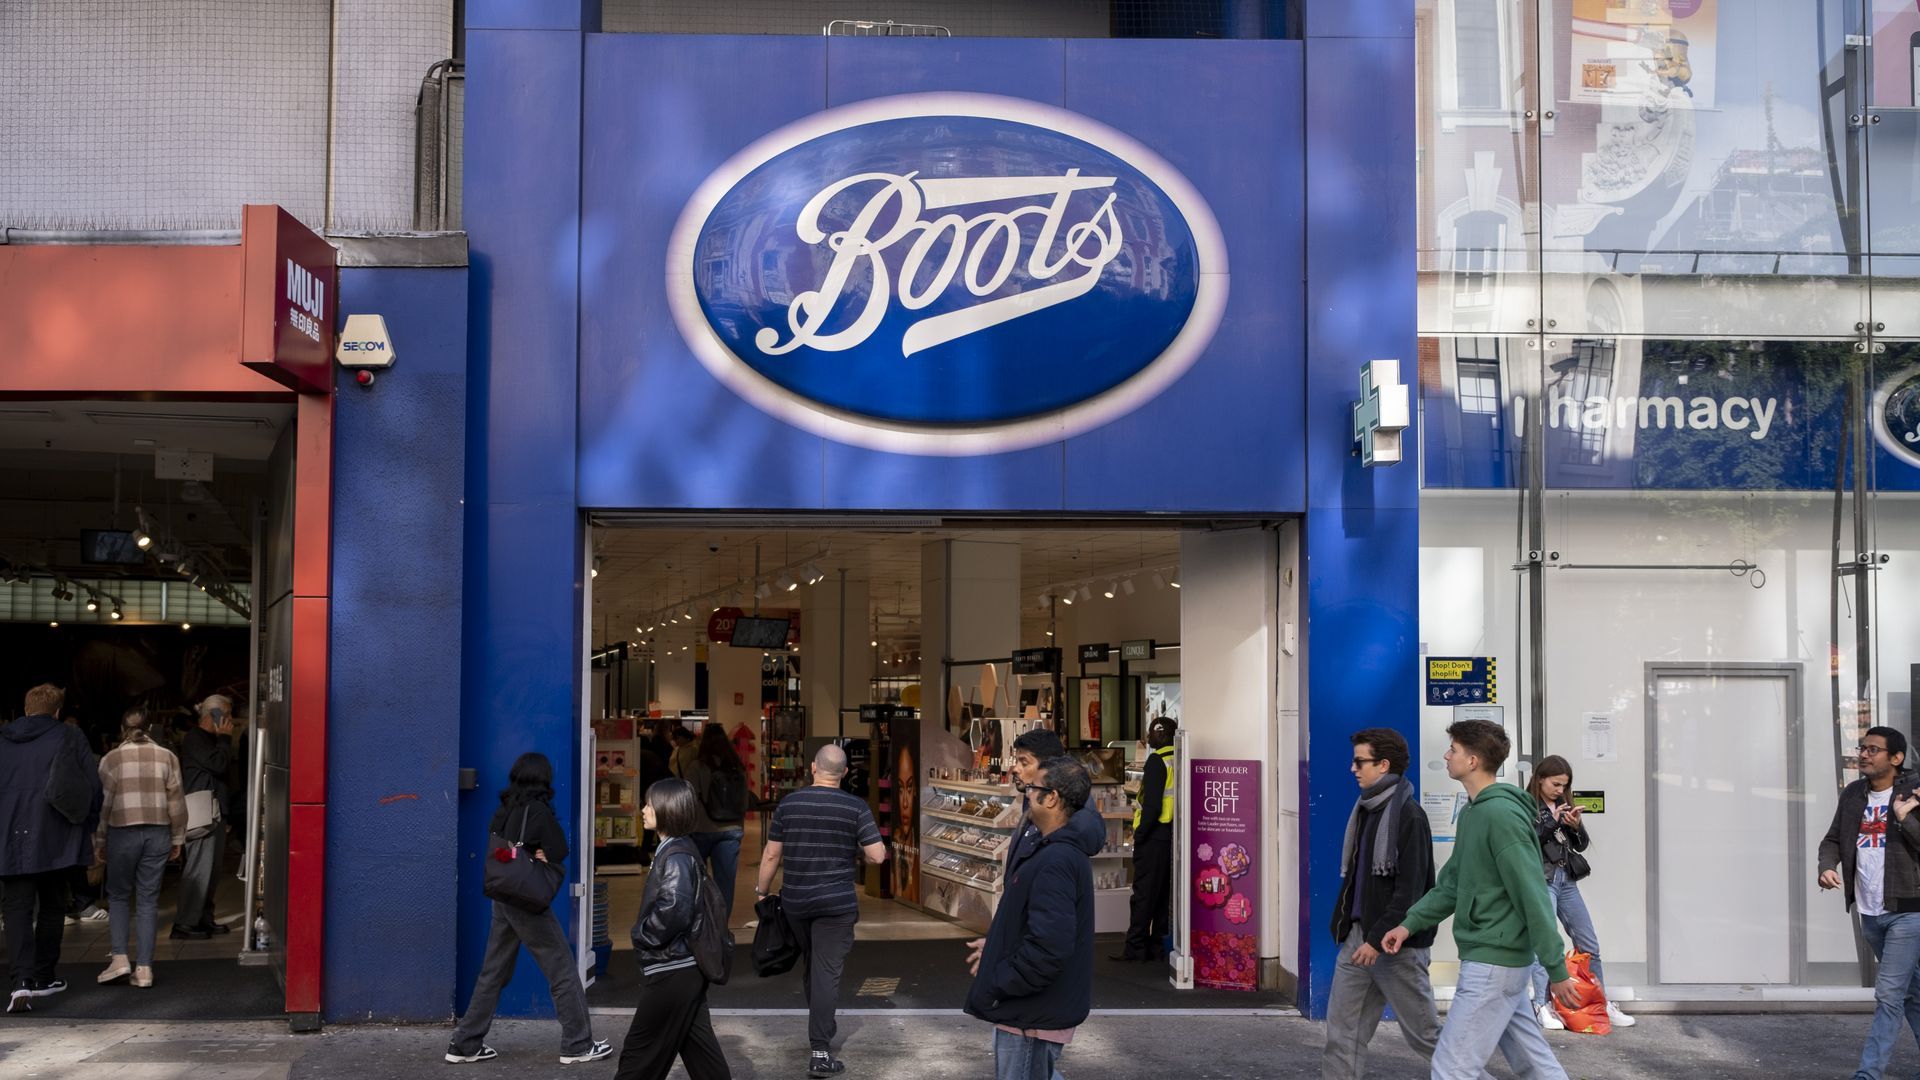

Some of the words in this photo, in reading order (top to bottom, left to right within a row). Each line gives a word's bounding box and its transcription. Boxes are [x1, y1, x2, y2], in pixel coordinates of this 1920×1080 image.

[755, 168, 1123, 357] Boots
[287, 257, 325, 321] MUJI
[290, 307, 320, 343] 無印良品
[343, 341, 385, 351] SECOM
[1432, 662, 1450, 671] Stop!
[1432, 670, 1460, 678] shoplift.
[1195, 765, 1216, 773] ESTÉE
[1217, 766, 1249, 774] LAUDER
[1205, 781, 1239, 797] FREE
[1204, 797, 1239, 813] GIFT
